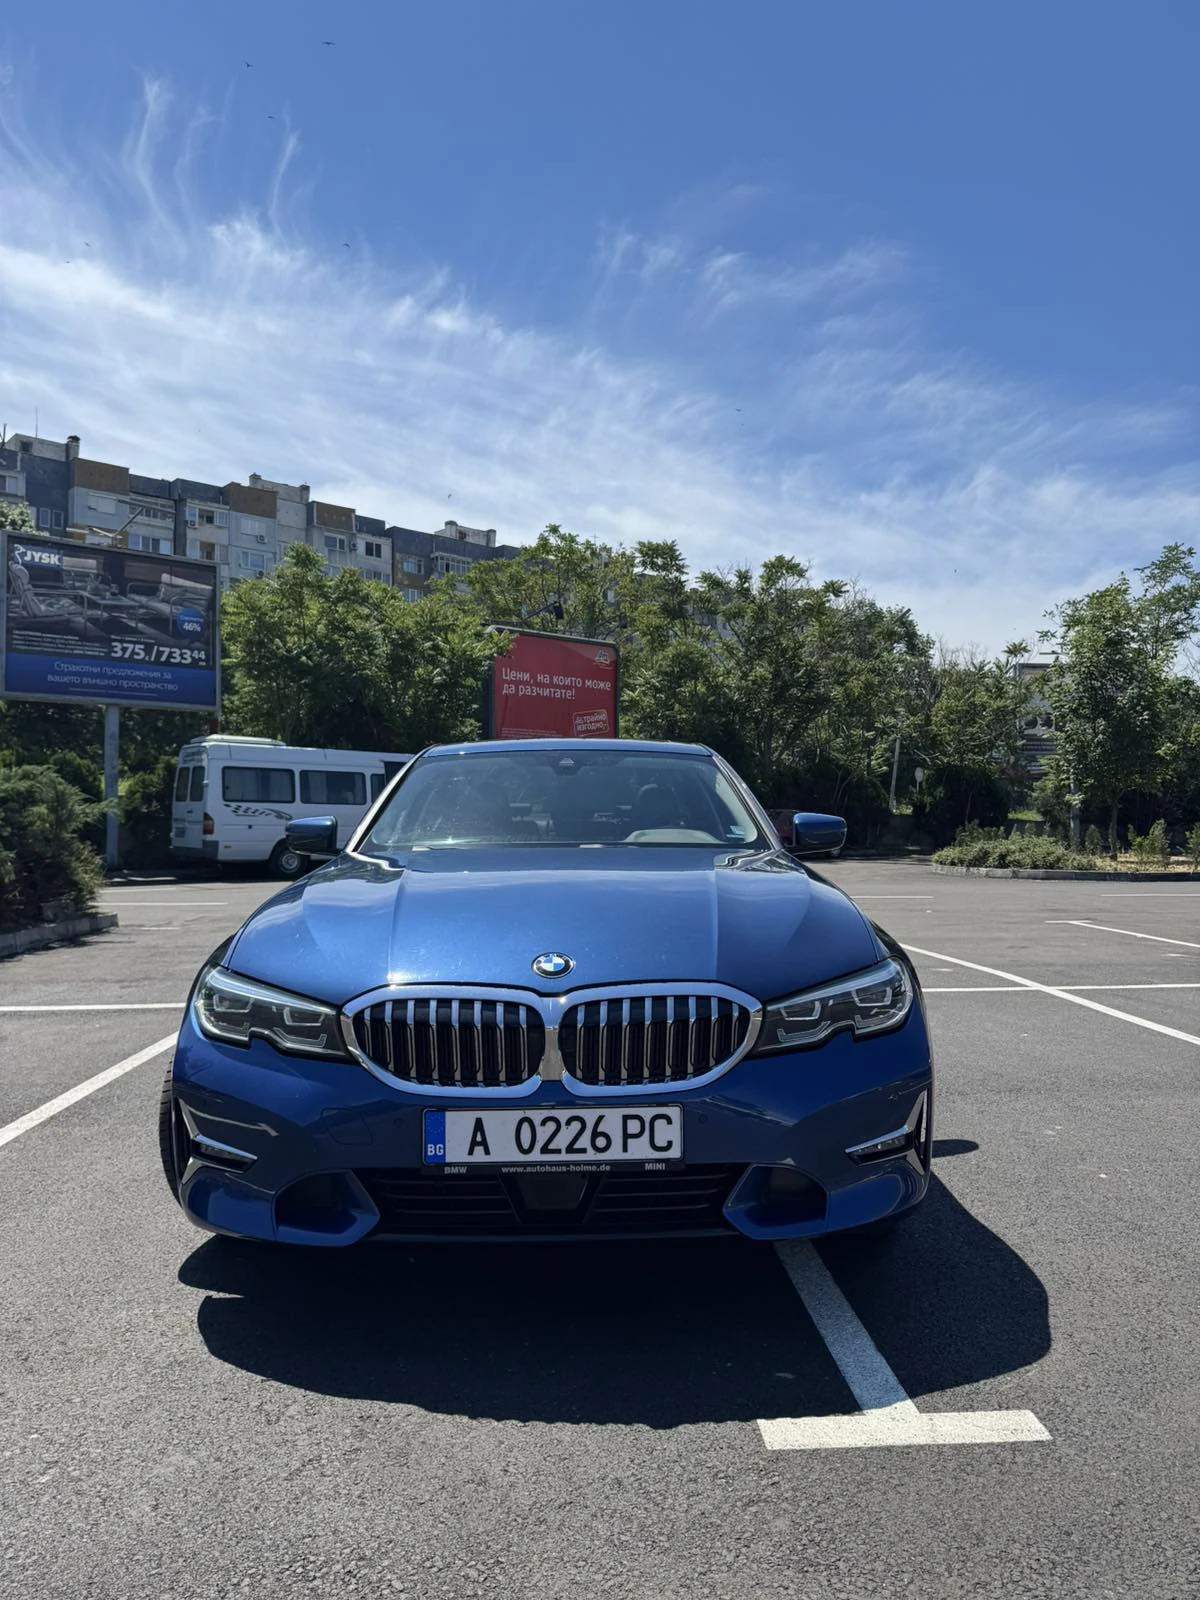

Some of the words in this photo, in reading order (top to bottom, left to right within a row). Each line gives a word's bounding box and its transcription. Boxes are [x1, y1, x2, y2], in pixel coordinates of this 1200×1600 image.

[24, 549, 61, 566] JYSK
[183, 622, 201, 632] 46%
[502, 667, 534, 684] Цени,
[537, 674, 550, 683] на
[552, 675, 582, 688] които
[585, 679, 612, 691] може
[502, 683, 516, 695] да
[518, 684, 576, 700] разчитате!
[467, 1117, 491, 1156] A
[514, 1114, 612, 1156] 0226
[621, 1113, 674, 1153] PC
[427, 1143, 444, 1156] BG
[444, 1166, 468, 1175] BMW
[501, 1163, 611, 1174] www.autohaus-holme.de
[644, 1162, 667, 1172] MINI
